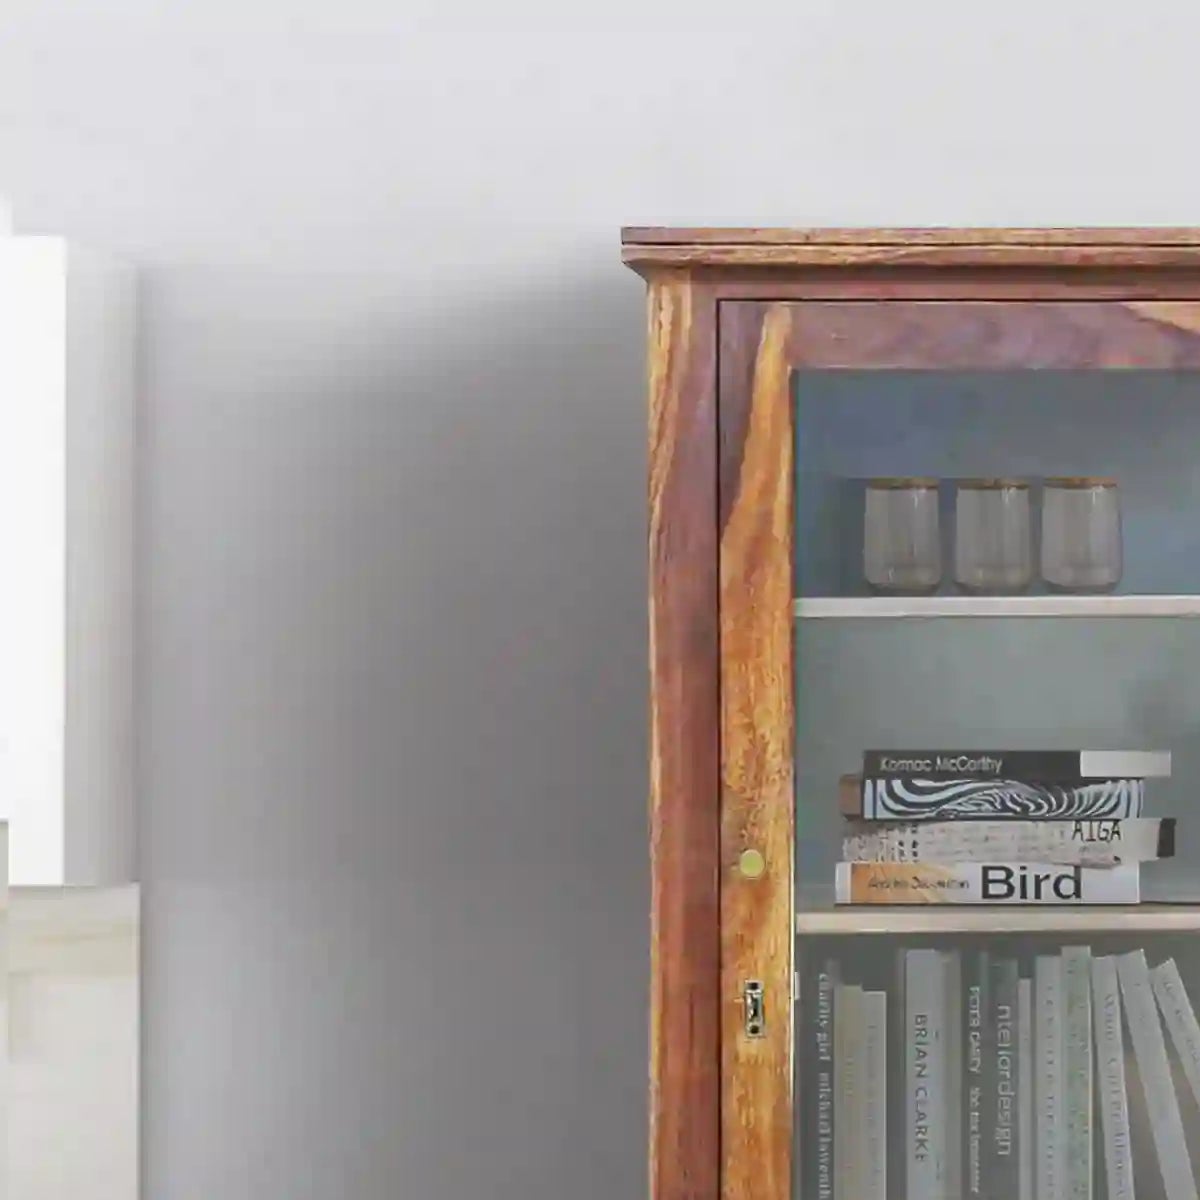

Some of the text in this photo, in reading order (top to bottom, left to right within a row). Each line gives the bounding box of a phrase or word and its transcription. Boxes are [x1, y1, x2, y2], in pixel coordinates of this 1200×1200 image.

[1072, 820, 1122, 842] AIGA
[982, 865, 1082, 900] Bird
[914, 1014, 929, 1079] BRIAN
